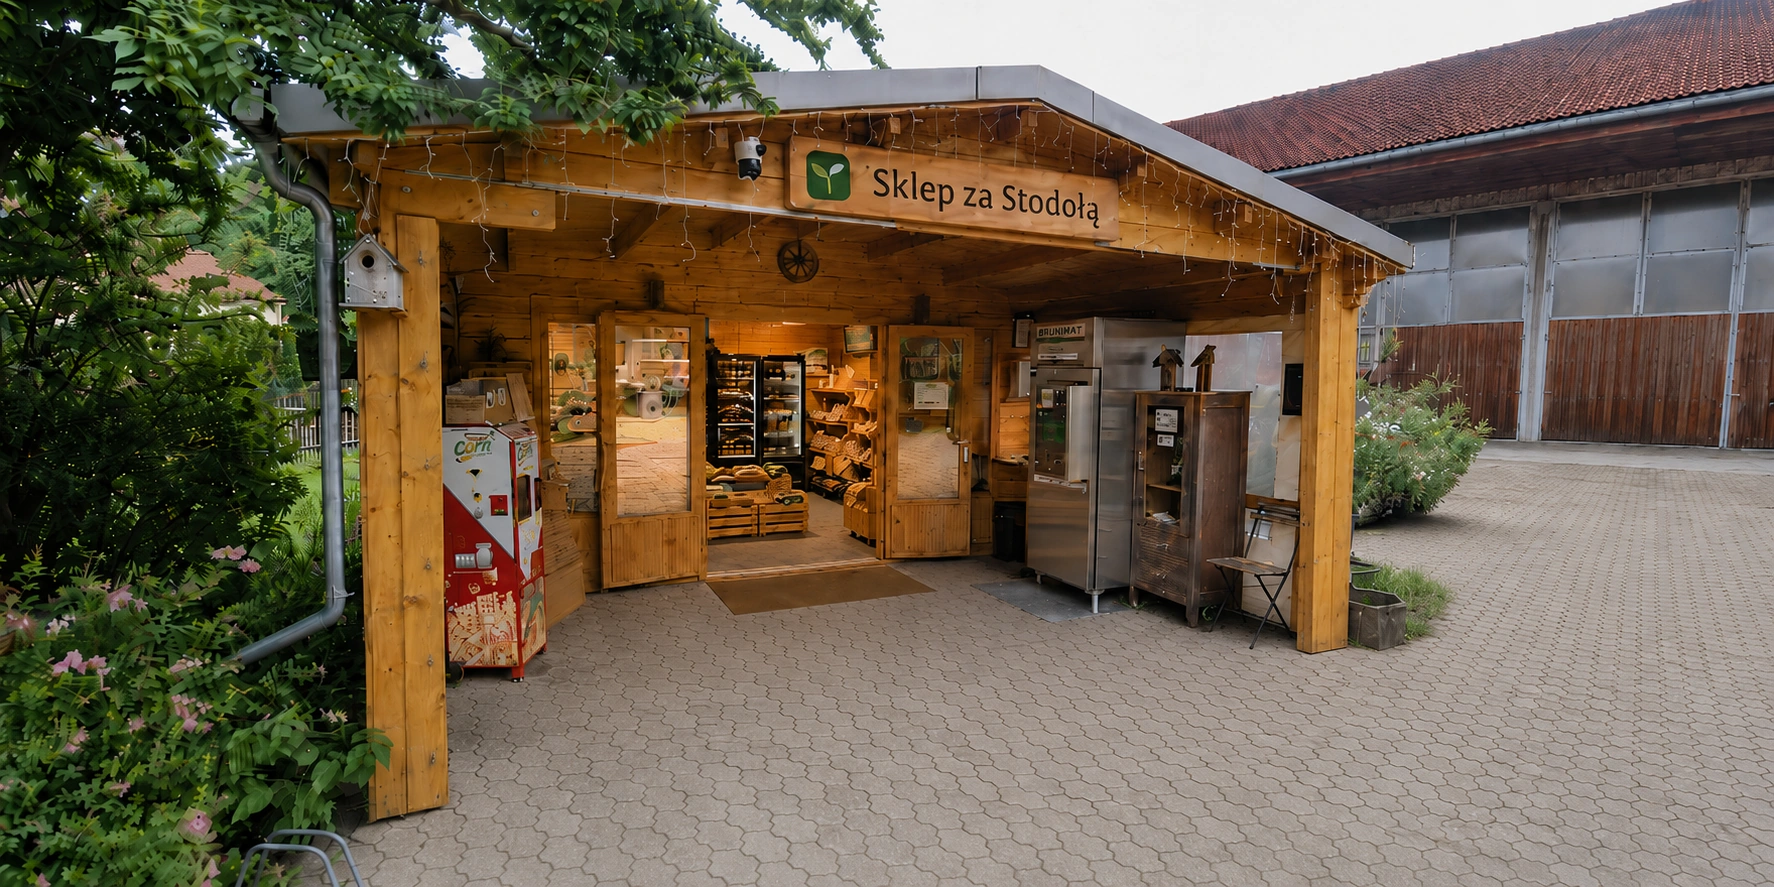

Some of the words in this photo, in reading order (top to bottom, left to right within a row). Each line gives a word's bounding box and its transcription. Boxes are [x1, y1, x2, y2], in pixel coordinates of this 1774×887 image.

[873, 168, 955, 212] Sklep
[963, 184, 993, 209] za
[1002, 185, 1099, 229] Stodołą
